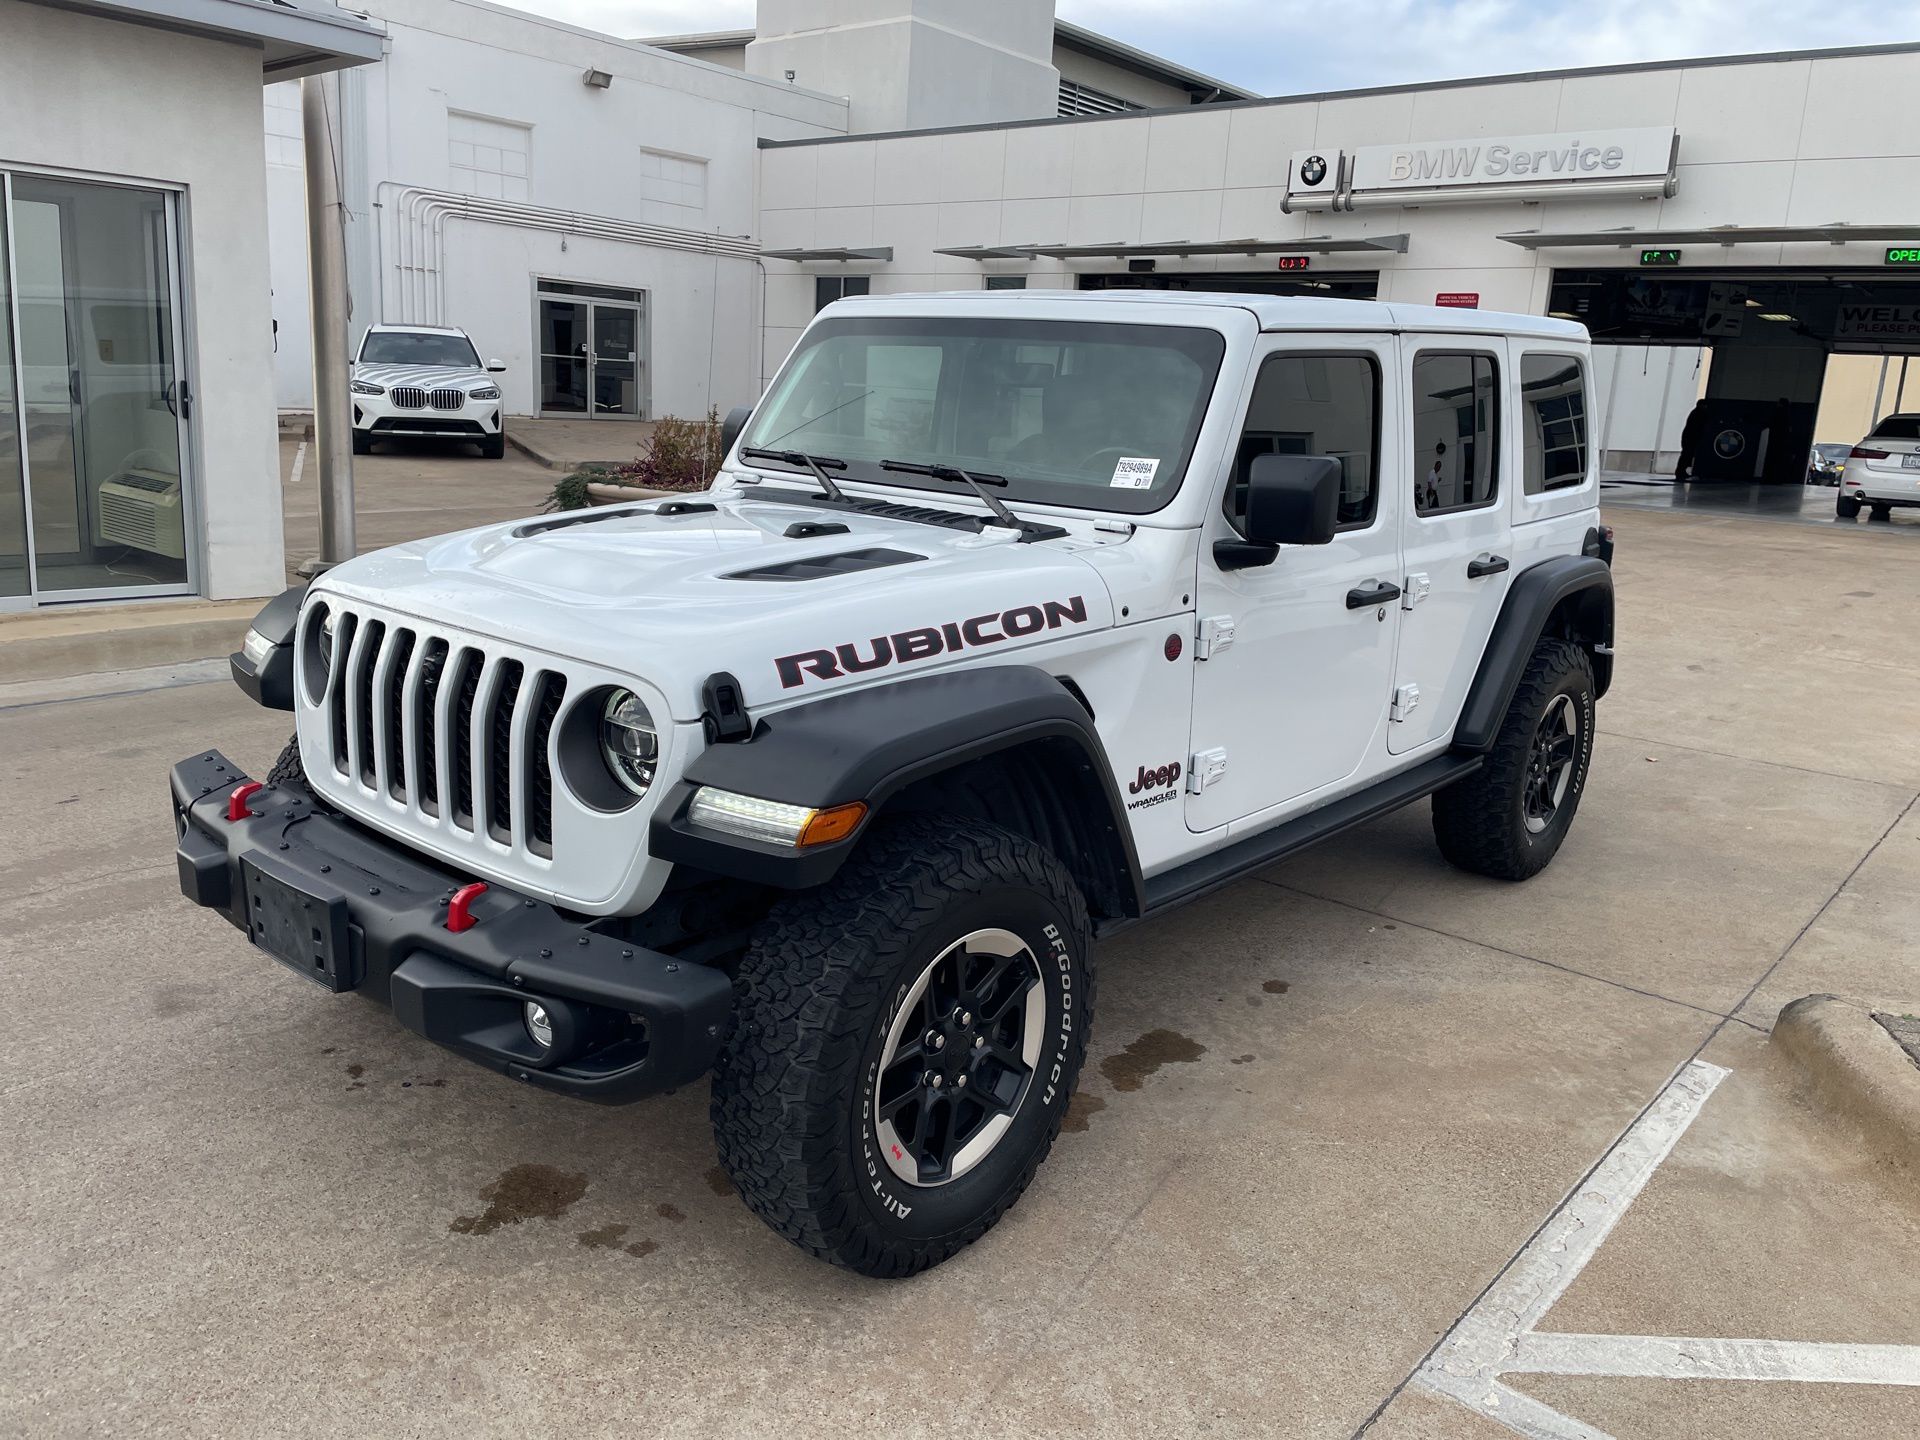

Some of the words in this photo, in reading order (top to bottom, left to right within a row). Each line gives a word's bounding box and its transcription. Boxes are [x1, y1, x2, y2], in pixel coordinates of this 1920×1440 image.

[1389, 146, 1481, 181] BMW
[1485, 140, 1623, 176] Service
[1889, 250, 1920, 261] OPE
[1856, 322, 1903, 334] PLEASE
[774, 595, 1087, 689] RUBICON
[1572, 691, 1590, 794] BFGoodrich
[1129, 762, 1181, 794] Jeep
[1127, 789, 1177, 810] WRANGLER
[1142, 795, 1177, 809] UNLIMITED
[1043, 923, 1072, 1105] BFGoodrich
[862, 1061, 912, 1220] All-Terrain
